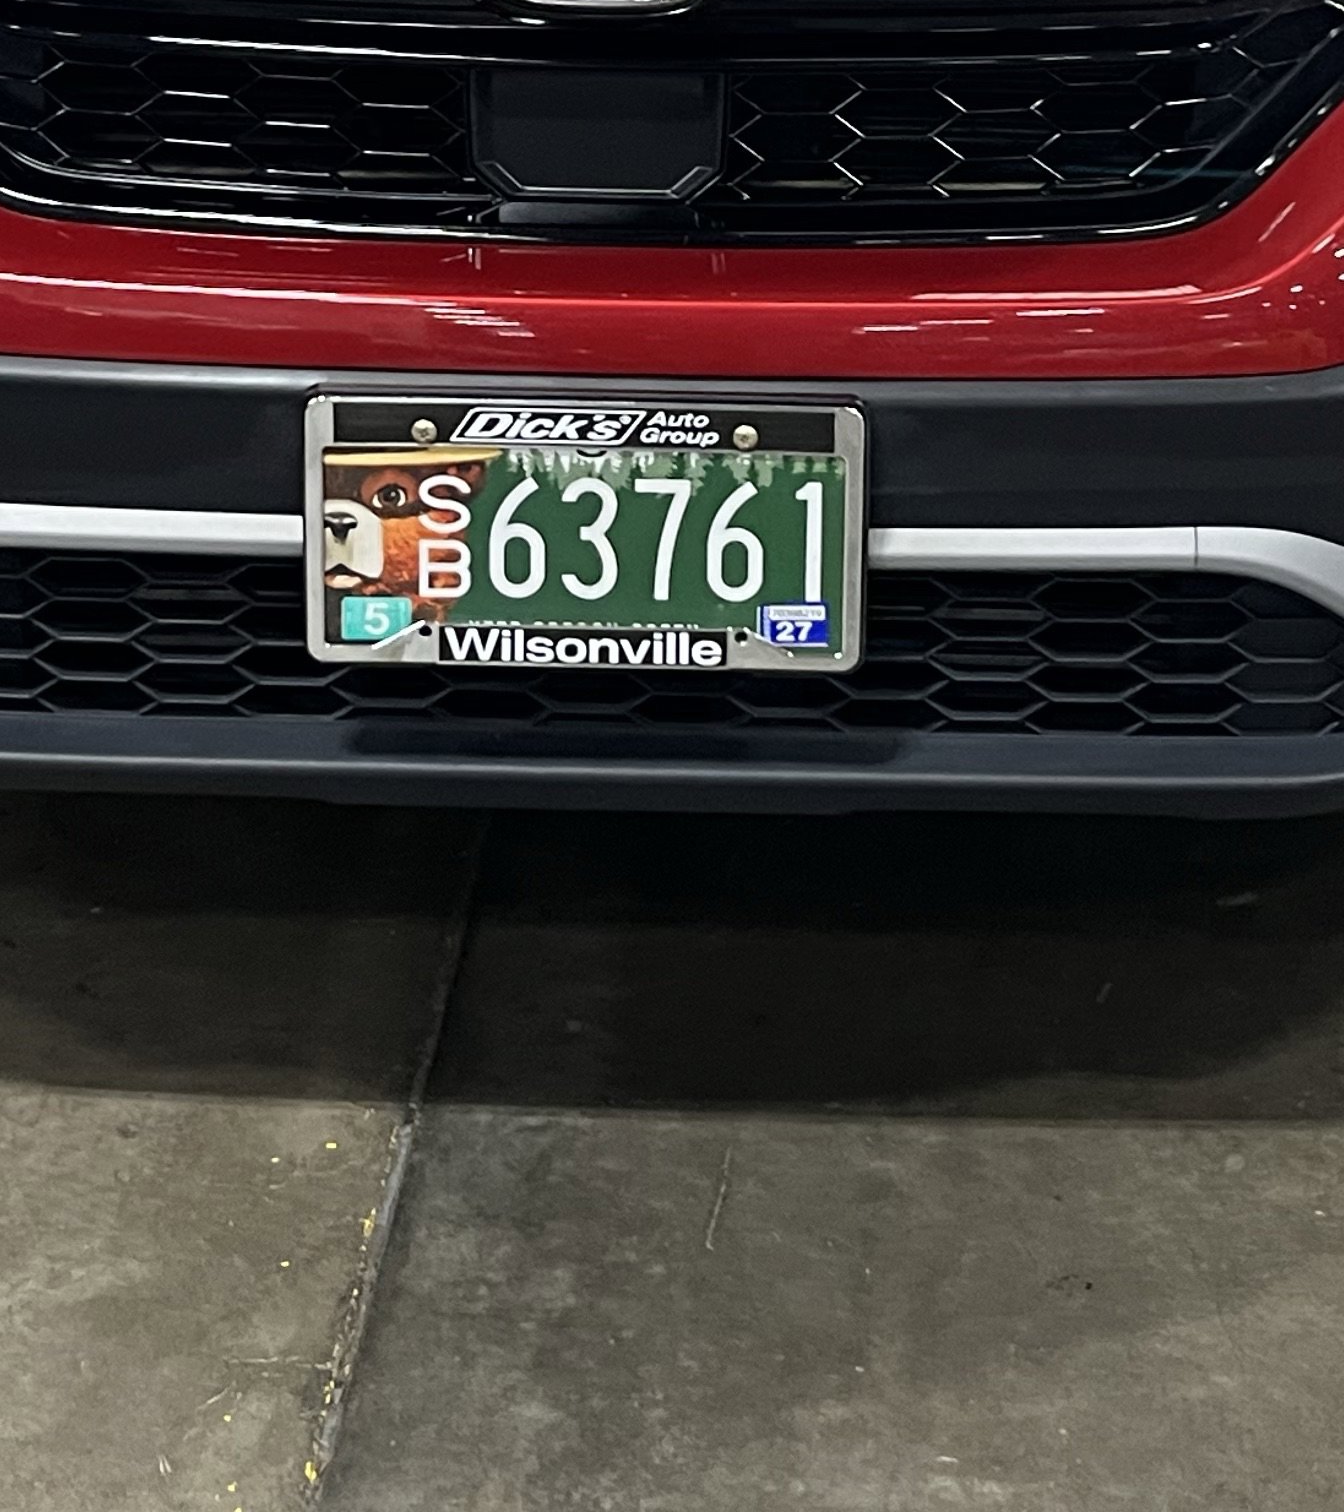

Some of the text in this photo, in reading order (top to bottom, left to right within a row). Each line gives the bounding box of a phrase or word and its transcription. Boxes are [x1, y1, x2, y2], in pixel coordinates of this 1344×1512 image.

[464, 412, 623, 441] Dick's
[646, 411, 710, 428] Auto
[639, 427, 720, 448] Group
[488, 476, 823, 604] 63761
[364, 602, 390, 636] 5
[775, 620, 813, 643] 27
[444, 625, 723, 667] Wilsonville
